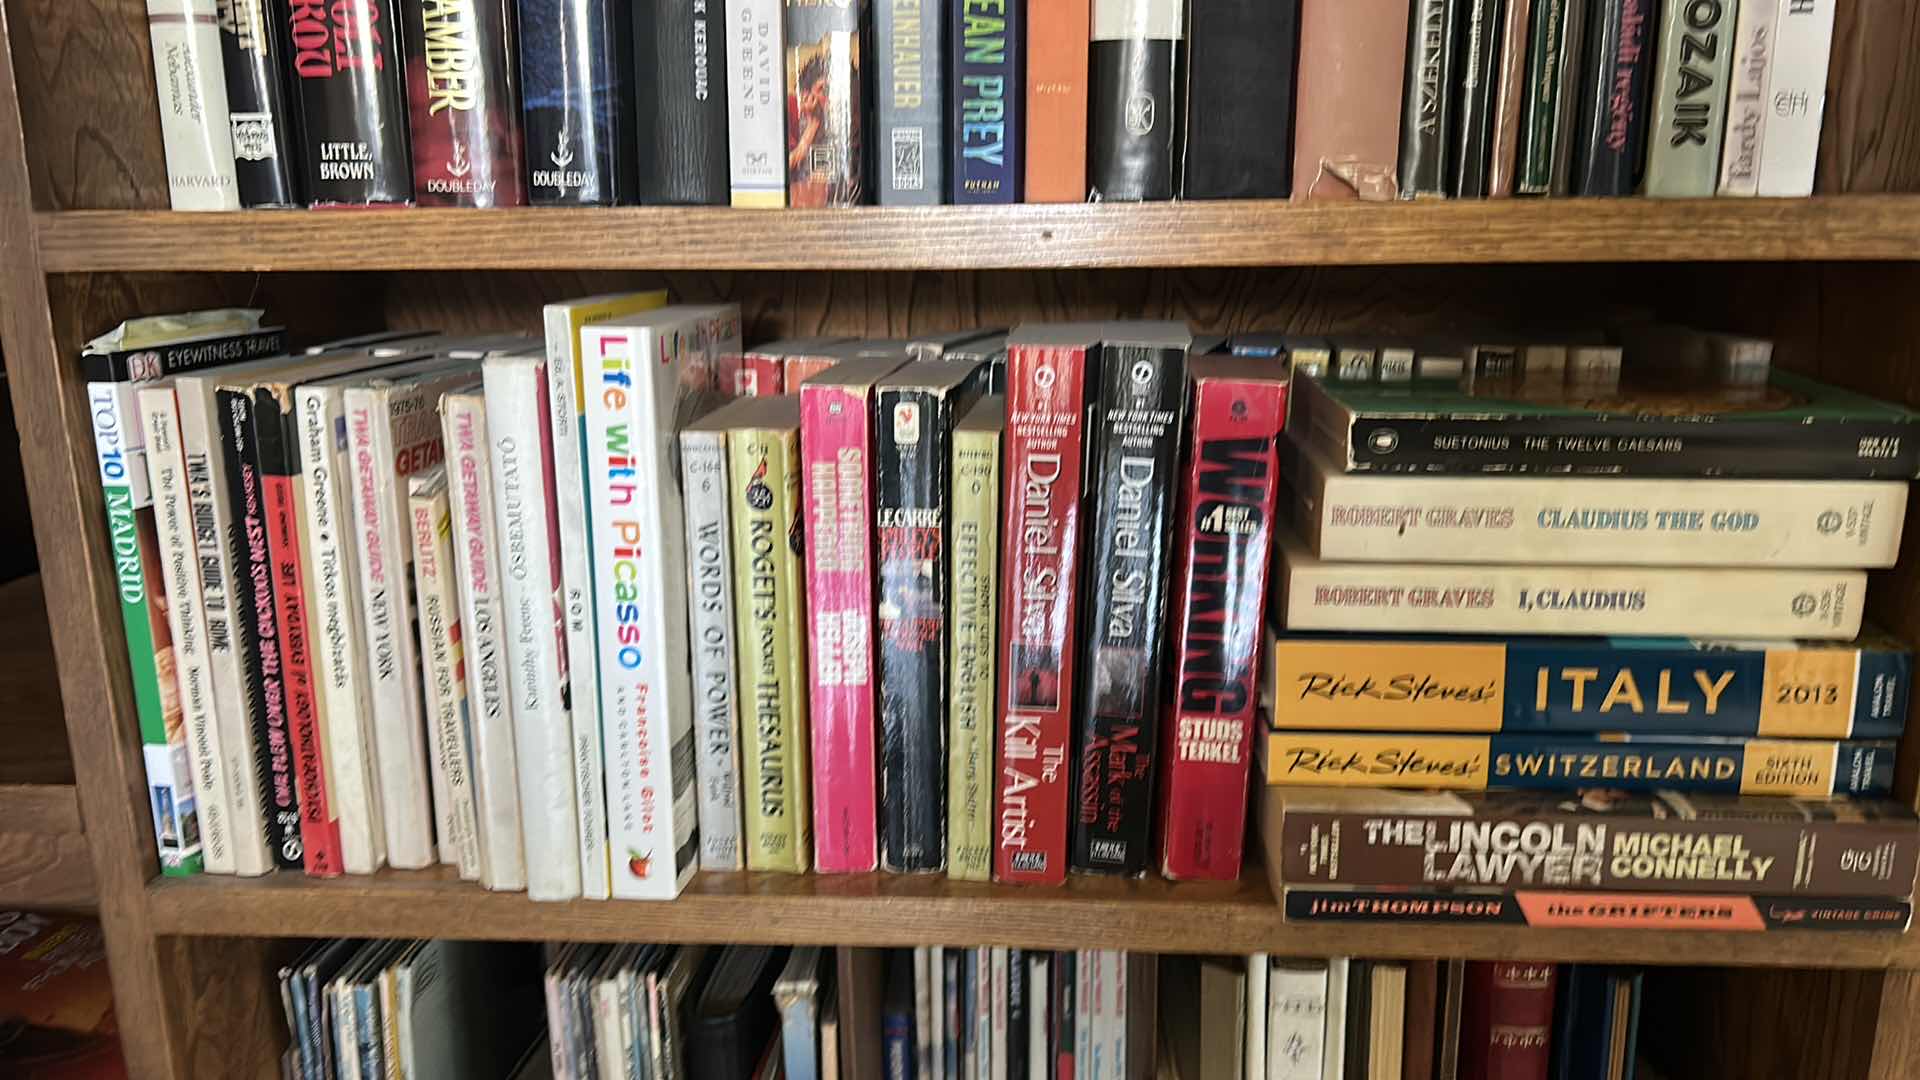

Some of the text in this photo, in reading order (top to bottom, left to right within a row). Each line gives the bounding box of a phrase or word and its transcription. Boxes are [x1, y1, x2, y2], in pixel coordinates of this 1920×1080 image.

[694, 19, 708, 102] KEROUAC
[741, 9, 755, 119] GREENE
[758, 22, 771, 105] DAVID
[963, 76, 1005, 166] PREY
[319, 162, 374, 180] BROWN
[320, 143, 373, 161] LITTLE,
[171, 174, 231, 187] HARVARD
[427, 178, 497, 193] DOUBLEDAY
[533, 171, 596, 187] DOUBLEDAY
[128, 353, 161, 382] DK
[167, 336, 280, 368] EYEWITNESS TRAVEL
[93, 391, 125, 479] TOP 10
[306, 396, 325, 462] Graham
[1010, 411, 1077, 426] NEW YORK TIMES
[1016, 425, 1068, 438] BESTSELLING
[1107, 409, 1175, 425] NEW YORK TIMES
[1113, 422, 1165, 436] BESTSELLING
[1026, 438, 1058, 451] AUTHOR
[1121, 436, 1154, 449] AUTHOR
[1432, 433, 1683, 453] SUETONIUS THE TWELVE CAESARS
[313, 467, 330, 526] Greene
[600, 336, 642, 670] Life with Picasso
[1224, 506, 1251, 520] BEST
[194, 502, 217, 551] BUDGET
[1200, 504, 1224, 534] #1
[1224, 518, 1257, 534] SELLER
[1330, 504, 1761, 532] ROBERT GRAVES CLAUDIUS THE GOD
[106, 491, 144, 604] MADRID
[245, 516, 266, 562] NEST
[352, 409, 393, 681] TWA GETAWAY GUIDE NEW YORK
[414, 507, 437, 577] BERLITZ
[1021, 454, 1061, 637] Daniel Silva
[1109, 456, 1155, 639] Daniel Silva
[173, 551, 193, 599] Positive
[200, 556, 224, 592] GUIDE
[281, 560, 296, 587] LIFE
[457, 412, 502, 719] TWA GETAWAY GUIDE LOS ANGELES
[569, 589, 584, 632] ROM
[1313, 583, 1404, 608] ROBERT
[1407, 585, 1496, 609] GRAVES
[1536, 589, 1646, 612] CLAUDIUS
[179, 601, 196, 655] Thinking
[210, 618, 230, 656] ROME
[426, 593, 447, 661] RUSSIAN
[698, 520, 730, 756] WORDS OF POWER
[959, 521, 978, 730] EFFECTIVE ENGLISH
[259, 639, 279, 677] THE
[435, 665, 452, 697] FOR
[1298, 671, 1382, 701] Rick
[1536, 666, 1736, 715] ITALY
[1776, 683, 1839, 706] 2013
[263, 677, 284, 727] OVER
[193, 713, 209, 759] Vincent
[441, 701, 464, 787] TRAVELLERS
[1004, 715, 1041, 760] Kill
[1179, 716, 1244, 741] STUDS
[268, 727, 288, 772] FLEW
[617, 719, 632, 790] CARLTON
[757, 680, 784, 817] THESAURUS
[1042, 743, 1064, 784] The
[1107, 725, 1140, 786] Mark
[1179, 740, 1241, 764] TERKEL
[1286, 746, 1370, 775] Rick
[1495, 753, 1736, 781] SWITZERLAND
[1766, 757, 1814, 770] SIXTH
[200, 759, 217, 792] Peale
[273, 772, 291, 807] ONE
[1754, 770, 1820, 786] EDITION
[623, 793, 634, 832] LAKE
[641, 785, 656, 833] Gilot
[1001, 767, 1041, 850] Artist
[1363, 819, 1426, 846] THE
[1423, 819, 1608, 854] LINCOLN
[1611, 832, 1751, 858] MICHAEL
[1422, 850, 1604, 886] LAWYER
[1610, 857, 1776, 881] CONNELLY
[1811, 909, 1860, 921] VINTAGE
[1863, 909, 1901, 921] CRIME
